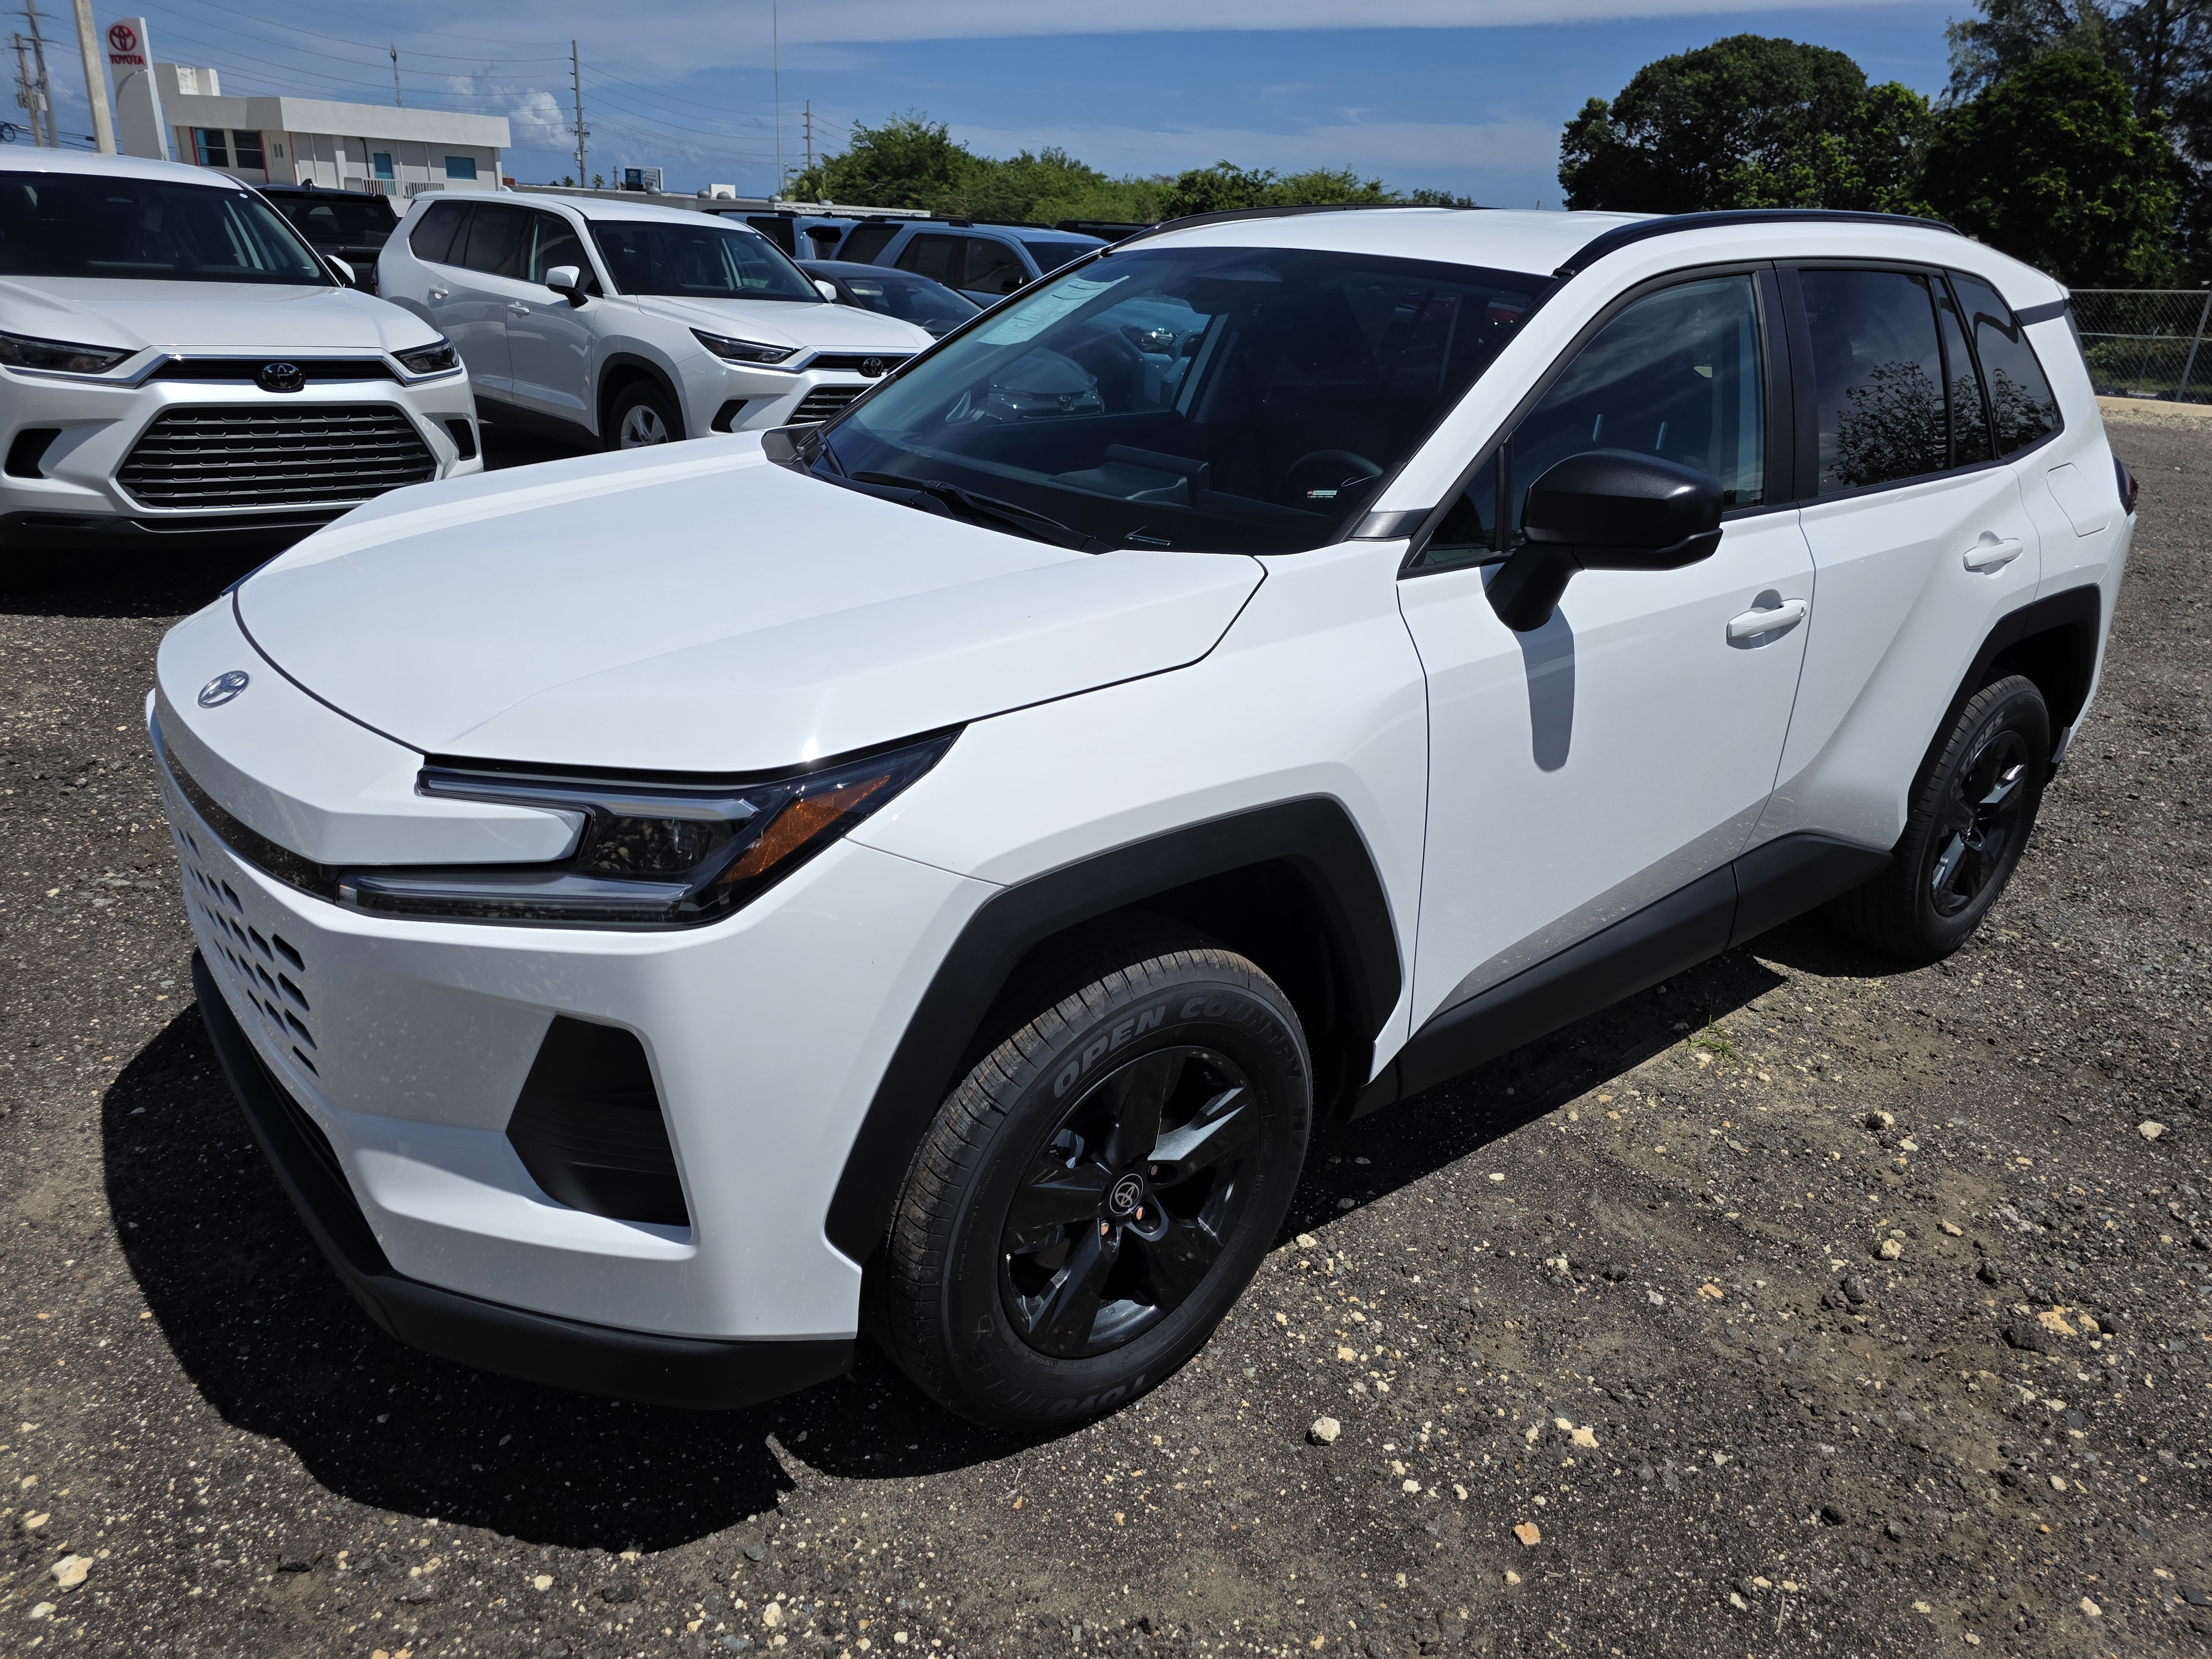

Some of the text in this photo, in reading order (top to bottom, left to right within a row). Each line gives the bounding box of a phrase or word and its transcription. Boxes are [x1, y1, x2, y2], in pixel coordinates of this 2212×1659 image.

[108, 54, 145, 65] TOYOTA
[1960, 710, 2005, 774] TIRES
[1053, 1005, 1166, 1098] OPEN
[1180, 997, 1302, 1078] COUNTRY
[1046, 1374, 1146, 1417] TOYO
